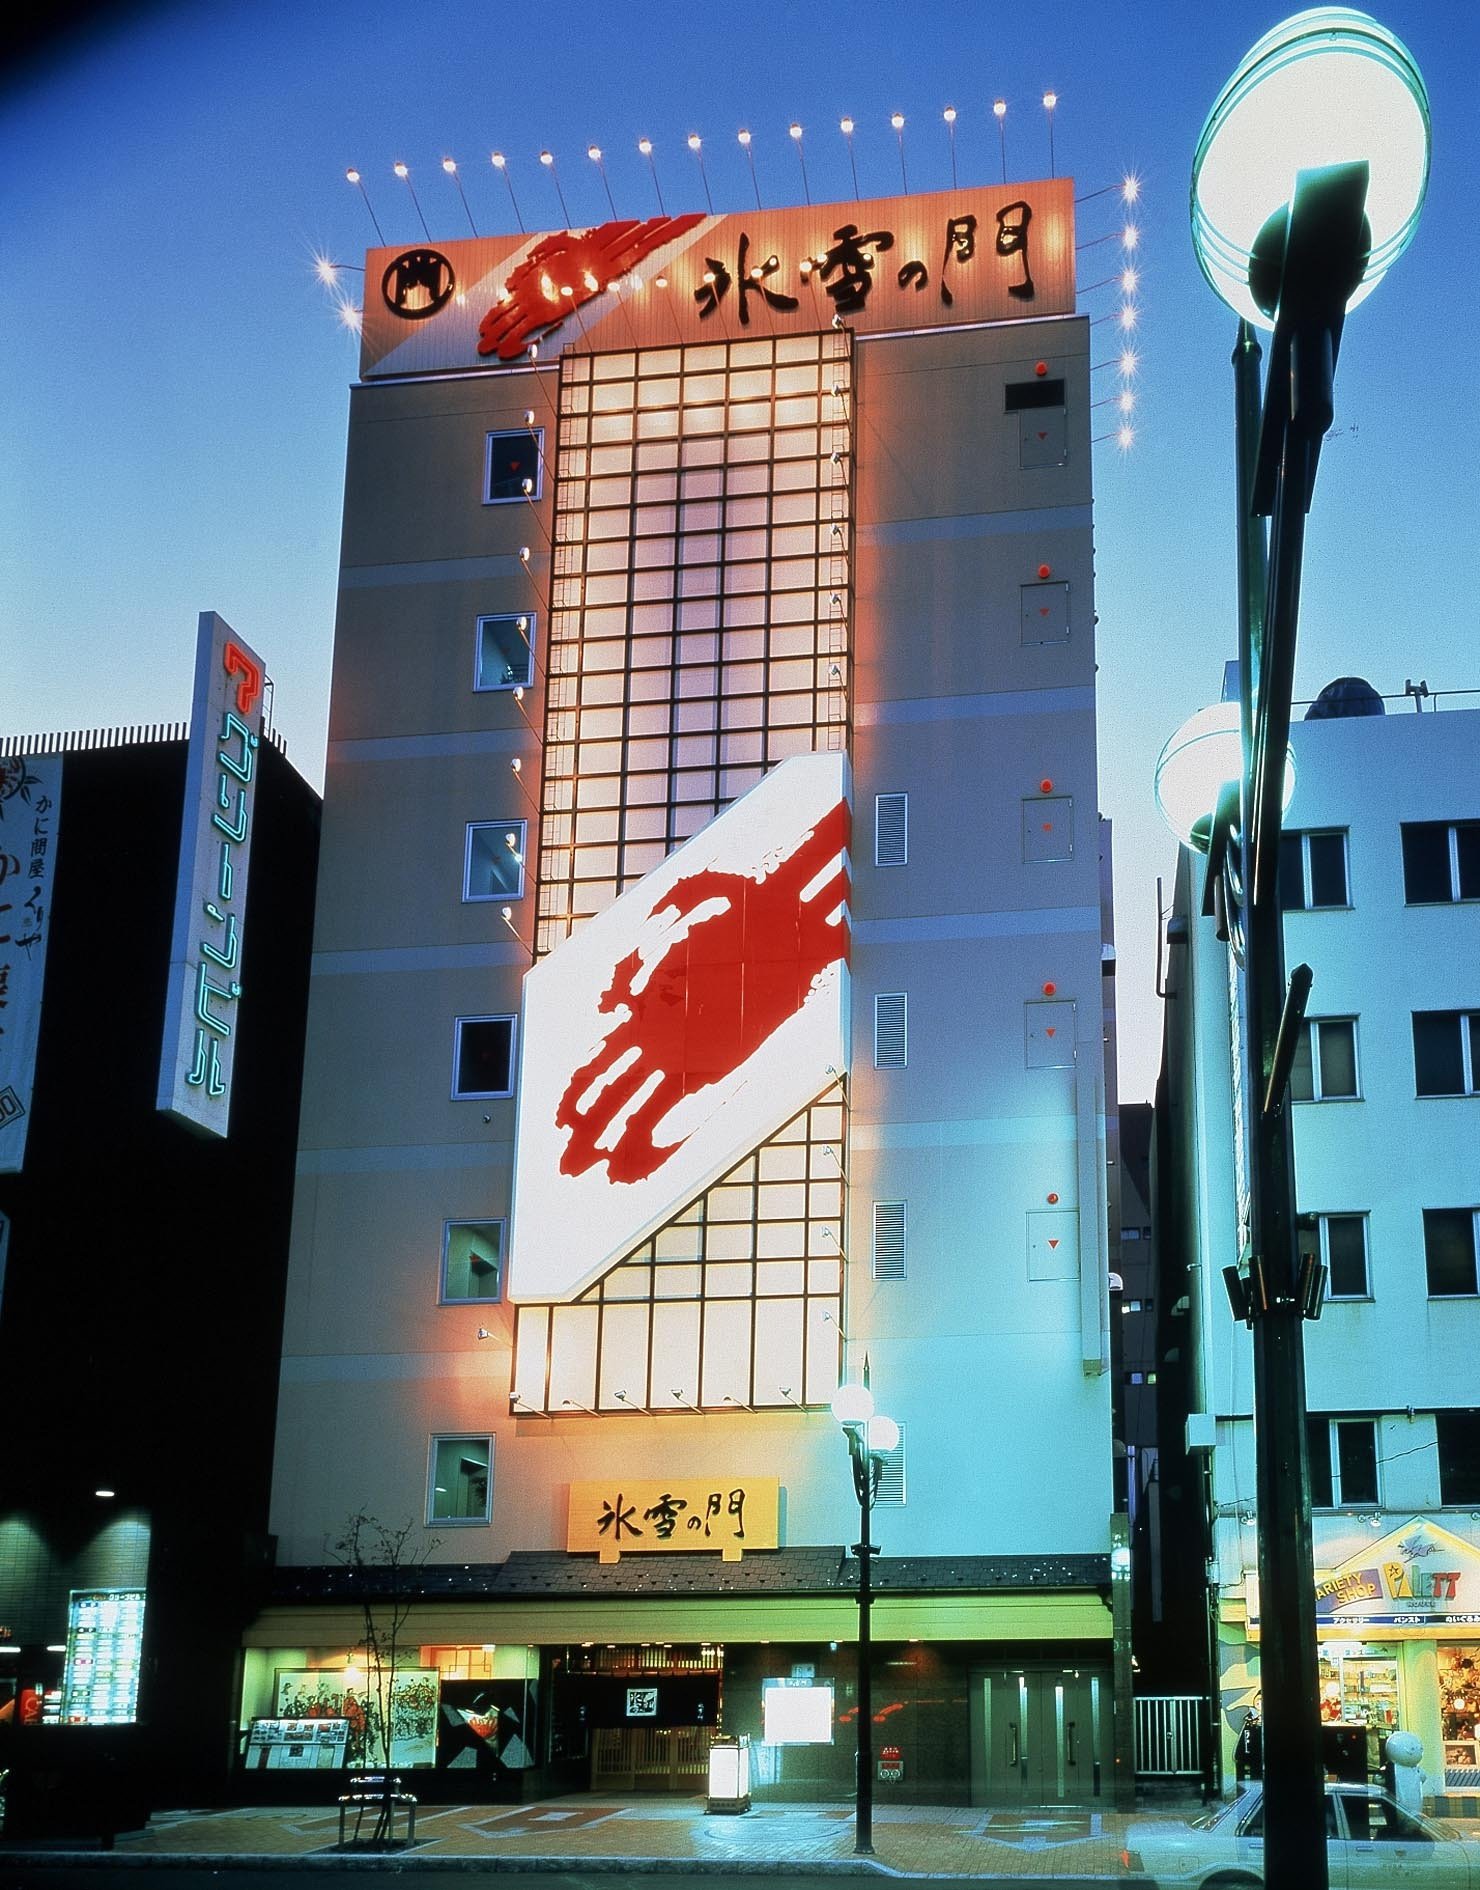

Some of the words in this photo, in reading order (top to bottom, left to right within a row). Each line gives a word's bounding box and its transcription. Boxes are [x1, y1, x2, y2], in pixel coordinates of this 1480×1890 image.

[693, 199, 1036, 327] 氷雪の門
[27, 794, 53, 880] かに問屋
[596, 1488, 746, 1541] 氷雪の門
[1315, 1572, 1363, 1600] ARIETY
[1336, 1583, 1377, 1605] SHOP
[1393, 1615, 1421, 1624] パンスト
